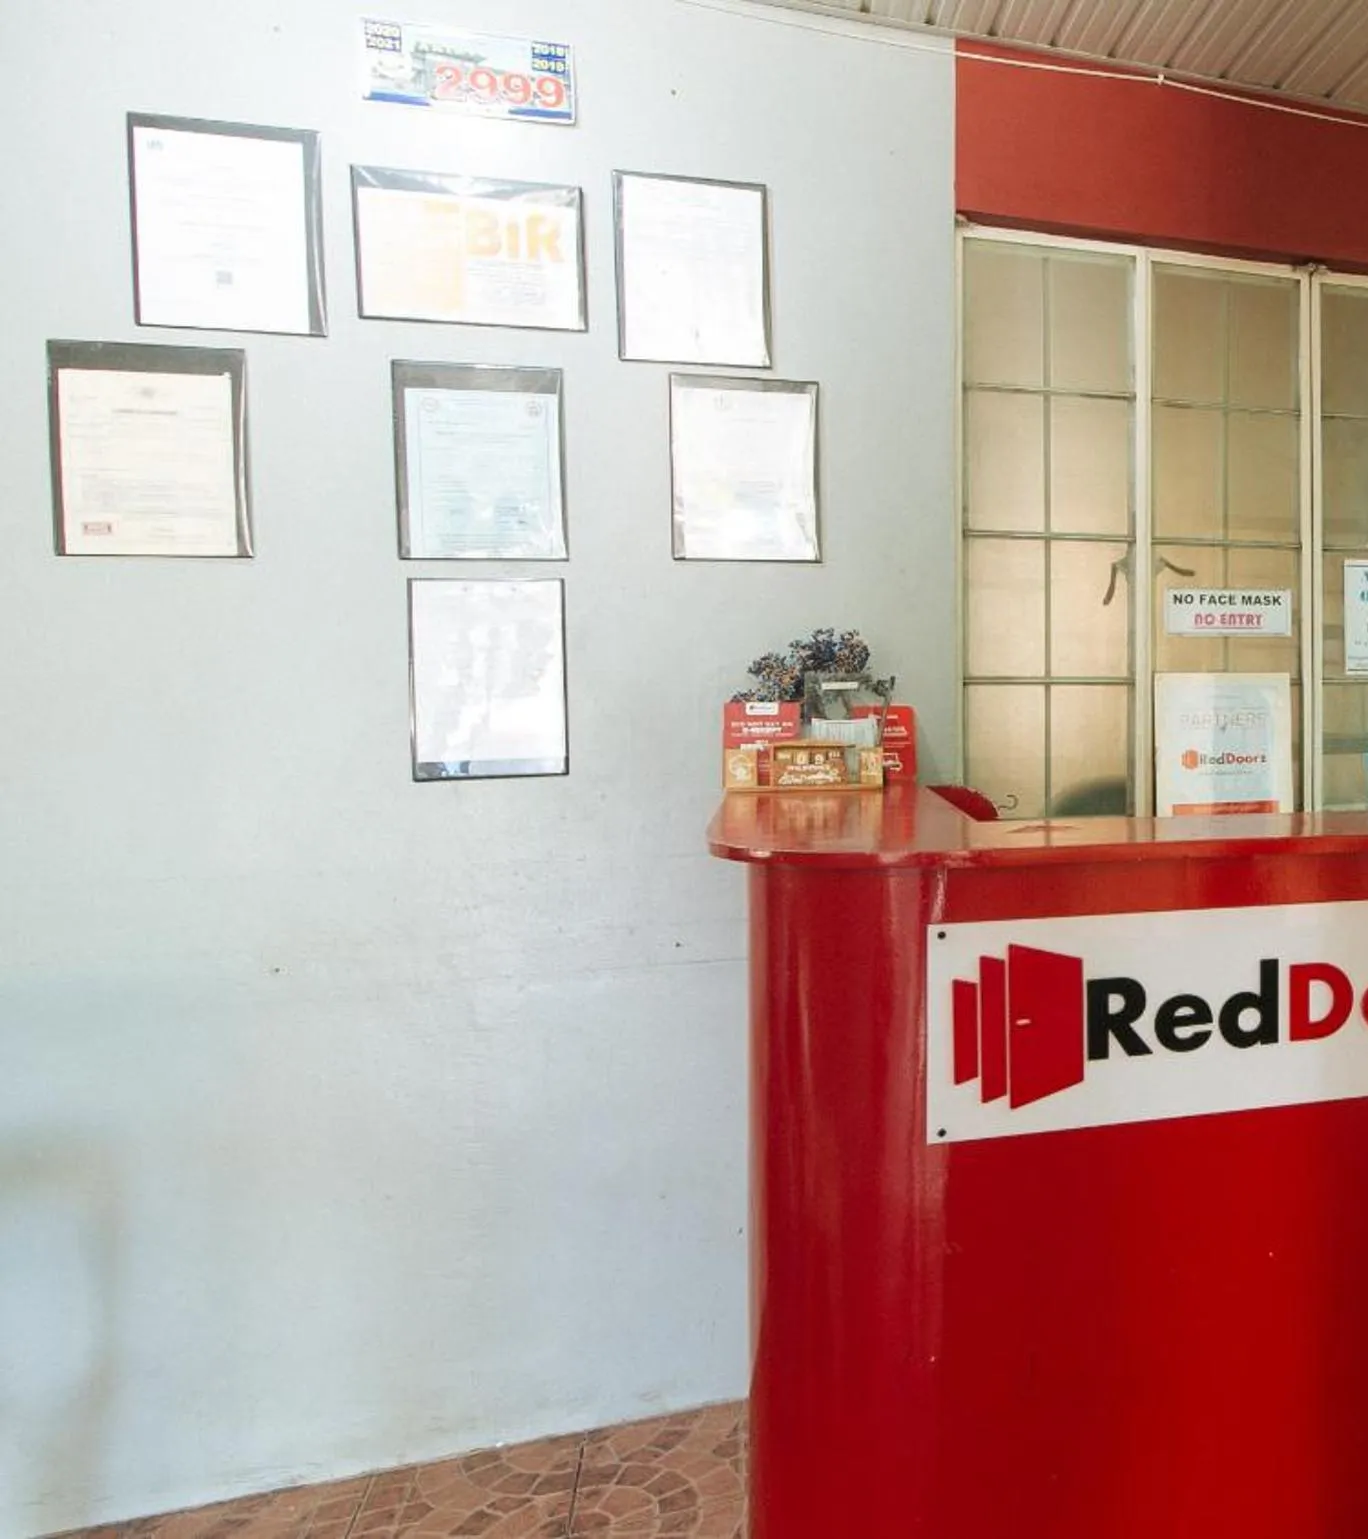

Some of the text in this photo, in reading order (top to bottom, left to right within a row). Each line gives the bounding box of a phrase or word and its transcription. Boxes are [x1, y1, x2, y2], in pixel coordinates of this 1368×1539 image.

[435, 64, 567, 108] 2999
[465, 208, 565, 263] BIR
[1173, 594, 1282, 606] NO FACE MASK
[1194, 613, 1263, 626] NO ENTRY
